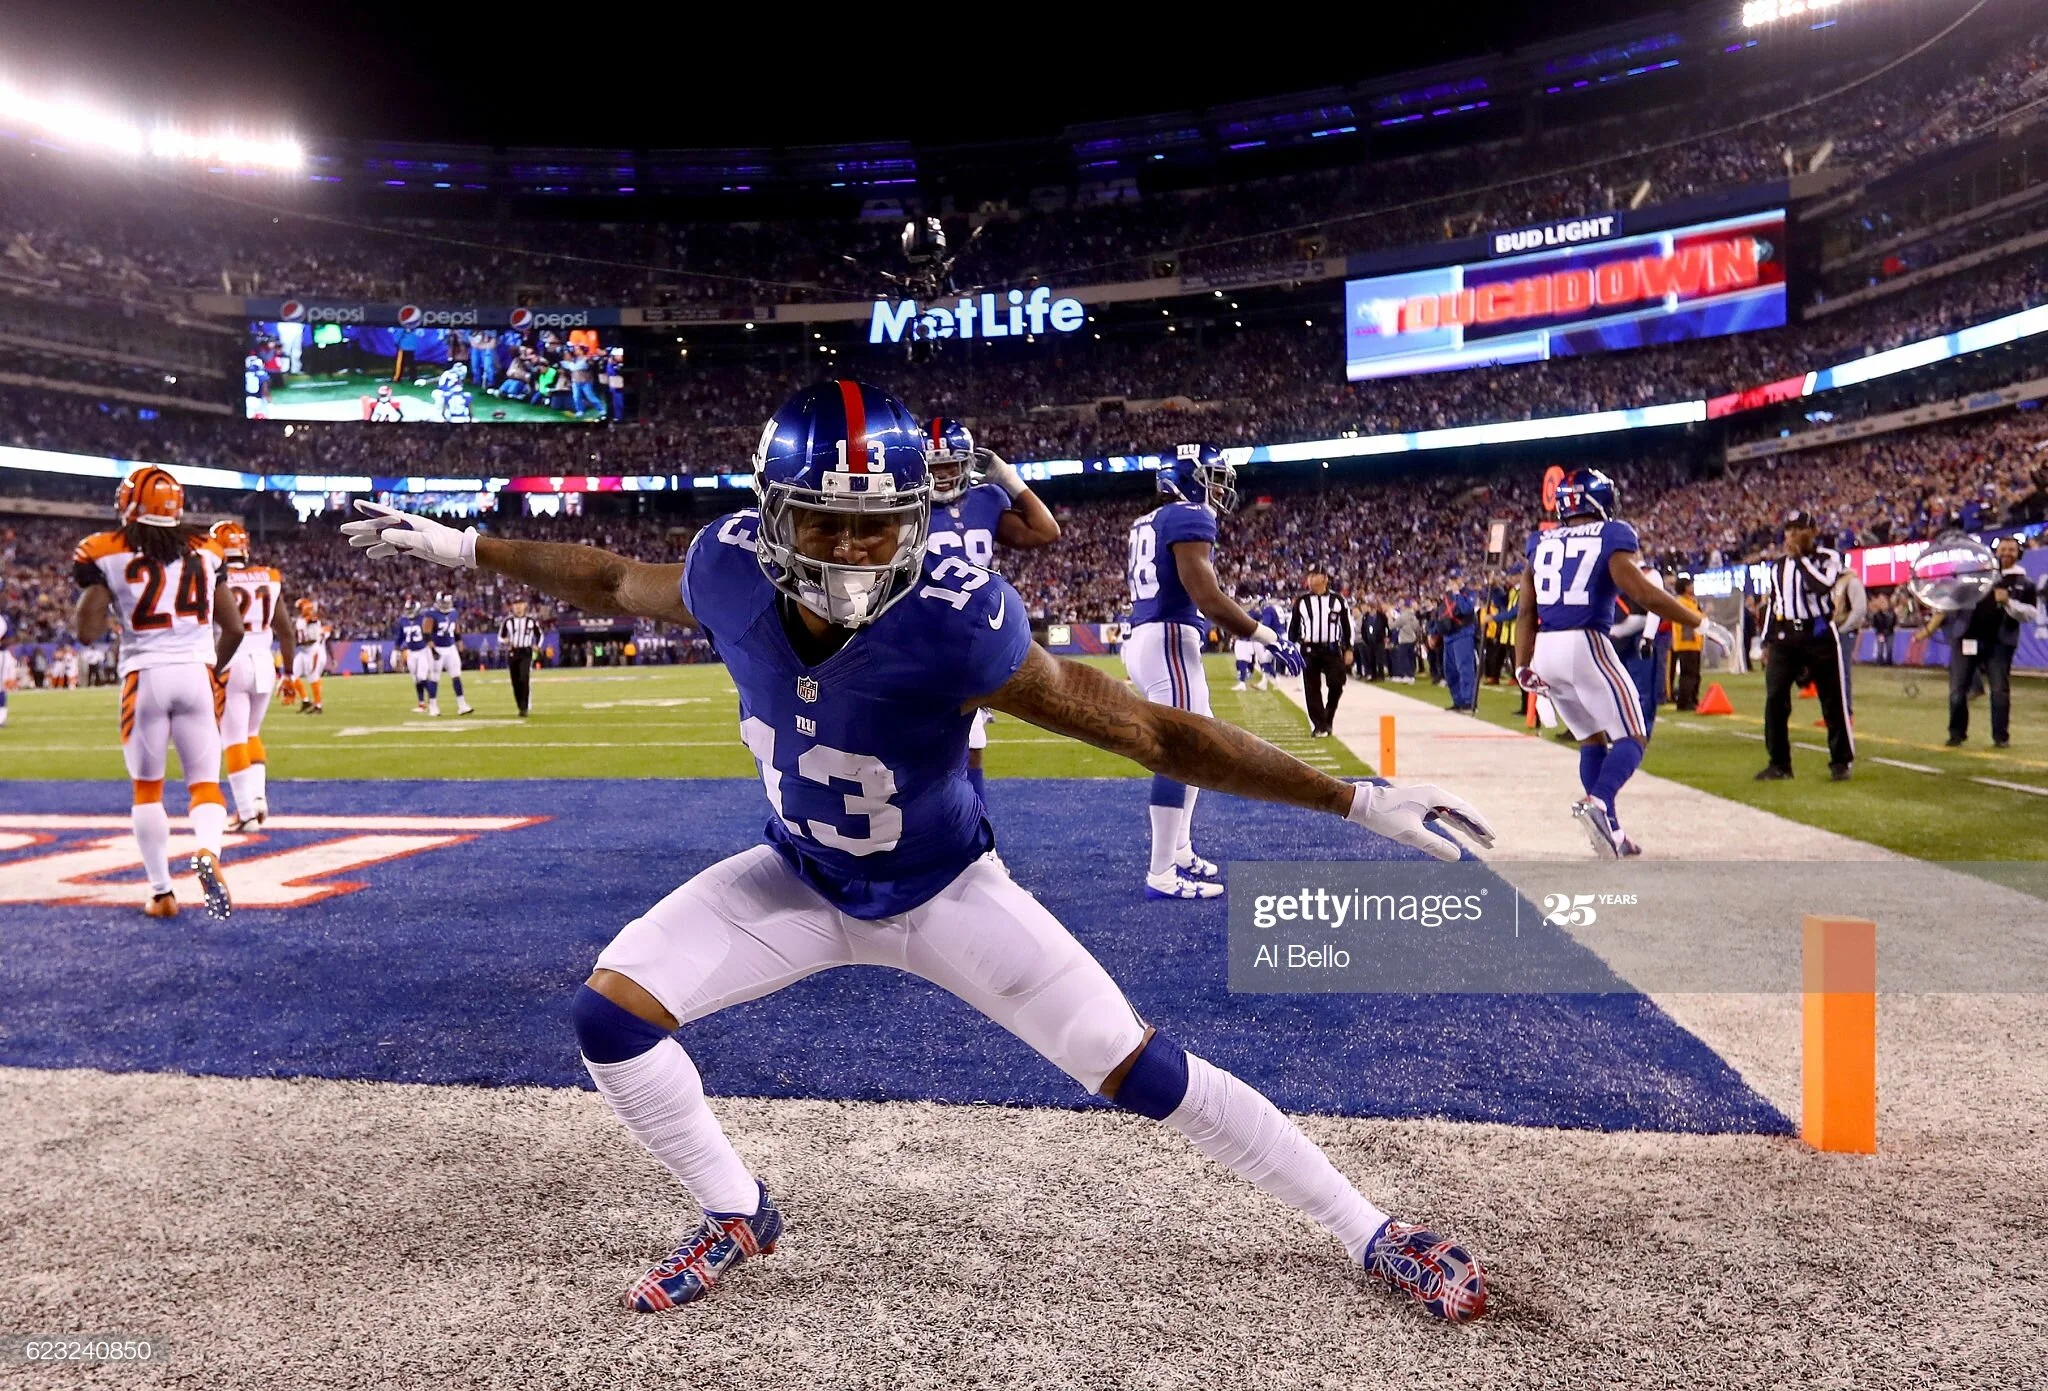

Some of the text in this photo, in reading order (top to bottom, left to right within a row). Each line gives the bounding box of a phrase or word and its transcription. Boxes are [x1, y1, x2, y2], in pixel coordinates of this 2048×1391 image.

[1495, 217, 1613, 253] BUD LIGHT
[1377, 237, 1759, 336] TOUCHDOWN
[307, 306, 364, 324] pepsi
[423, 309, 478, 326] pepsi
[533, 311, 588, 328] pepsi
[869, 286, 1084, 343] MetLife
[835, 439, 886, 473] 13
[927, 437, 948, 450] 68
[919, 556, 990, 611] 13
[1534, 537, 1603, 605] 87
[125, 555, 209, 631] 24
[402, 625, 423, 643] 73
[739, 715, 903, 857] 13
